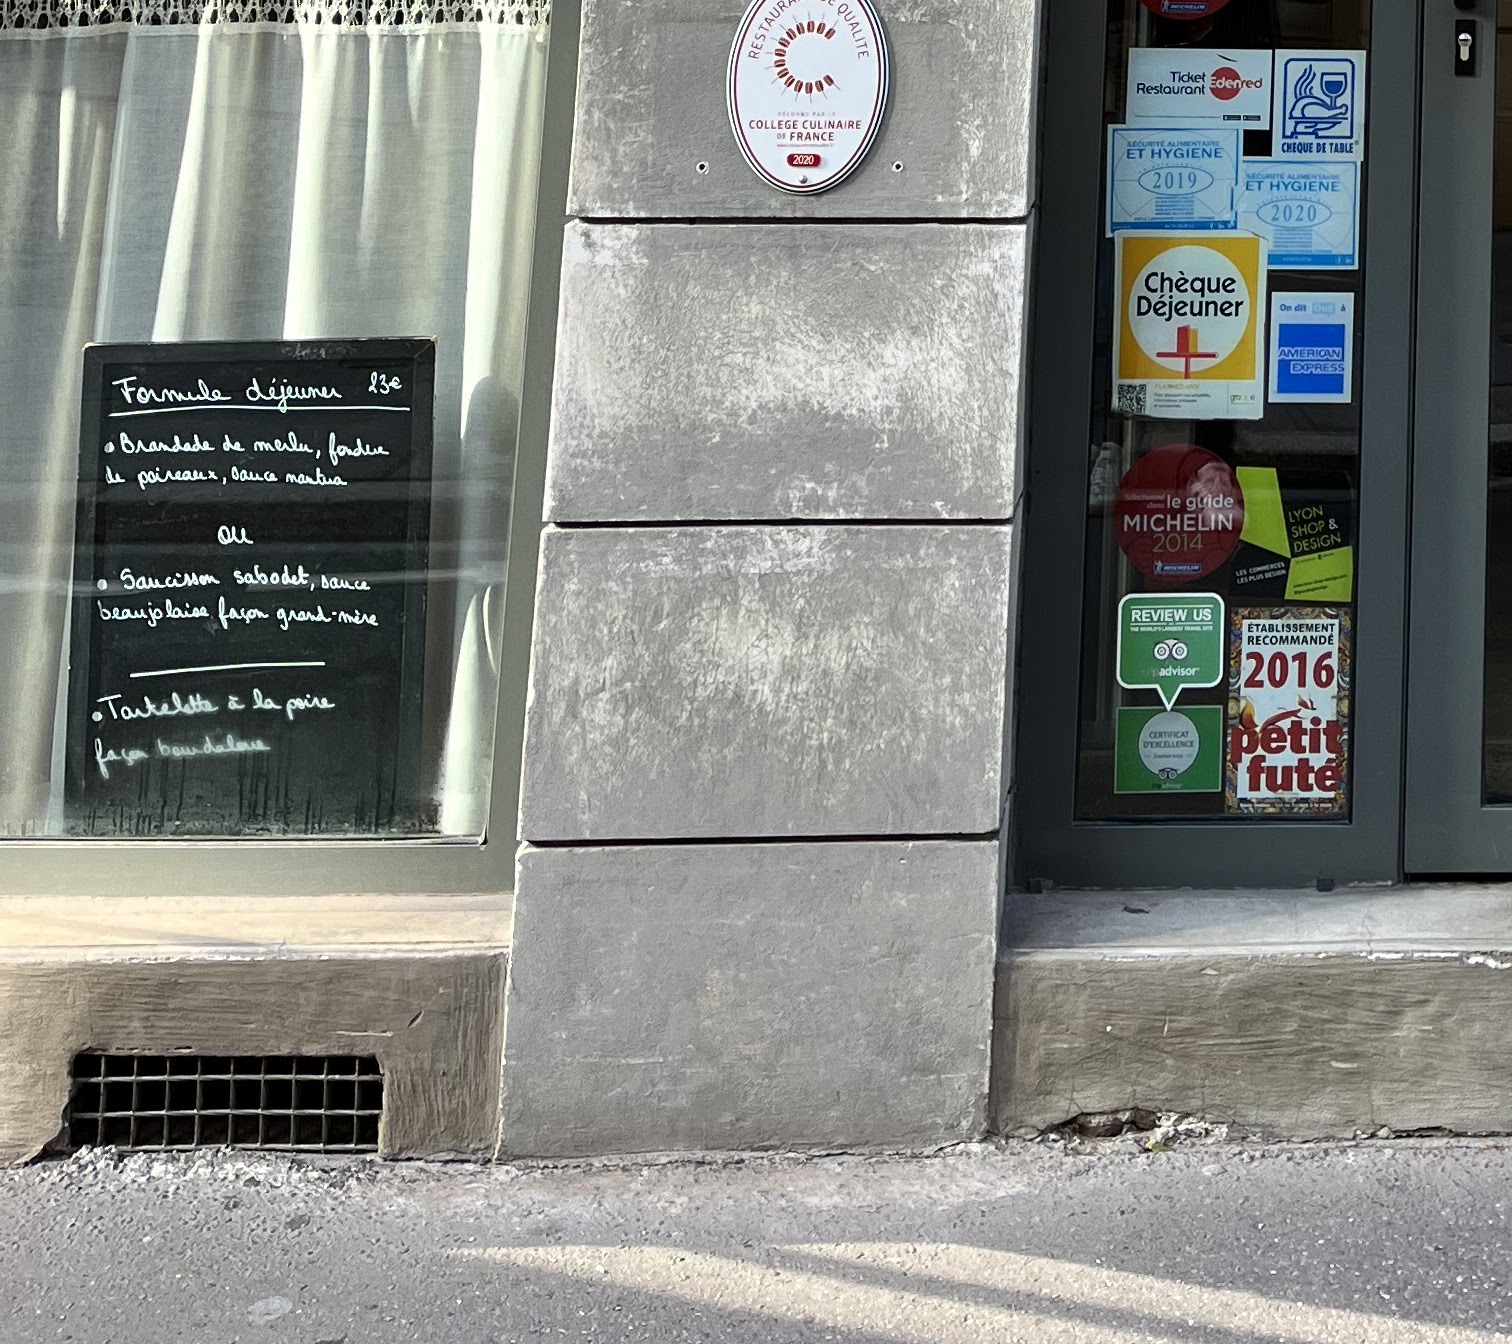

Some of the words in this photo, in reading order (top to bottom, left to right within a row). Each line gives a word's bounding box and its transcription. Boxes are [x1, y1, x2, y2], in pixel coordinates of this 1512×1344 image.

[837, 4, 869, 59] QUALITE
[1136, 83, 1205, 95] Restaurant
[1210, 77, 1262, 89] Edenred
[1170, 71, 1206, 83] Ticket
[749, 120, 798, 130] COLLEGE
[802, 120, 862, 129] CULINAIRE
[1126, 148, 1146, 159] ET
[1151, 148, 1223, 159] HYGIENE
[1281, 142, 1313, 154] CHEQUE
[1316, 143, 1327, 153] DE
[1329, 142, 1354, 153] TABLE
[792, 155, 814, 164] 2020
[1152, 172, 1197, 189] 2019
[1246, 181, 1264, 191] ET
[1269, 181, 1340, 192] HYGIENE
[1271, 205, 1317, 222] 2020
[1144, 271, 1237, 298] Chèque
[1137, 294, 1244, 322] Déjeuner
[1278, 348, 1341, 358] AMERICAN
[1292, 363, 1344, 372] EXPRESS
[112, 376, 232, 403] Formule
[246, 378, 343, 413] déjeuner
[119, 432, 215, 454] Brandade
[223, 434, 245, 452] de
[328, 432, 390, 466] fondue
[105, 465, 125, 485] de
[137, 467, 226, 490] poireaux,
[230, 468, 278, 483] sauce
[1166, 495, 1180, 508] le
[1186, 494, 1234, 511] guide
[1123, 513, 1233, 532] MICHELIN
[1288, 505, 1324, 523] LYON
[1291, 521, 1325, 538] SHOP
[1328, 518, 1339, 529] &
[1293, 532, 1342, 553] DESIGN
[120, 568, 220, 590] Saucisson
[233, 565, 315, 591] sabodet,
[321, 574, 371, 591] sauce
[97, 599, 209, 627] beaujolaise
[218, 596, 269, 630] façon
[276, 605, 379, 631] grand-mère
[1131, 609, 1187, 622] REVIEW
[1193, 608, 1212, 621] US
[1248, 621, 1336, 633] ÉTABLISSEMENT
[1248, 633, 1334, 646] RECOMMANDÉ
[1244, 651, 1335, 689] 2016
[97, 692, 219, 720] Tartelette
[228, 695, 245, 711] à
[253, 688, 282, 710] la
[286, 693, 335, 720] poire
[1230, 716, 1343, 771] petit
[94, 737, 149, 779] façon
[1247, 754, 1342, 793] futé
